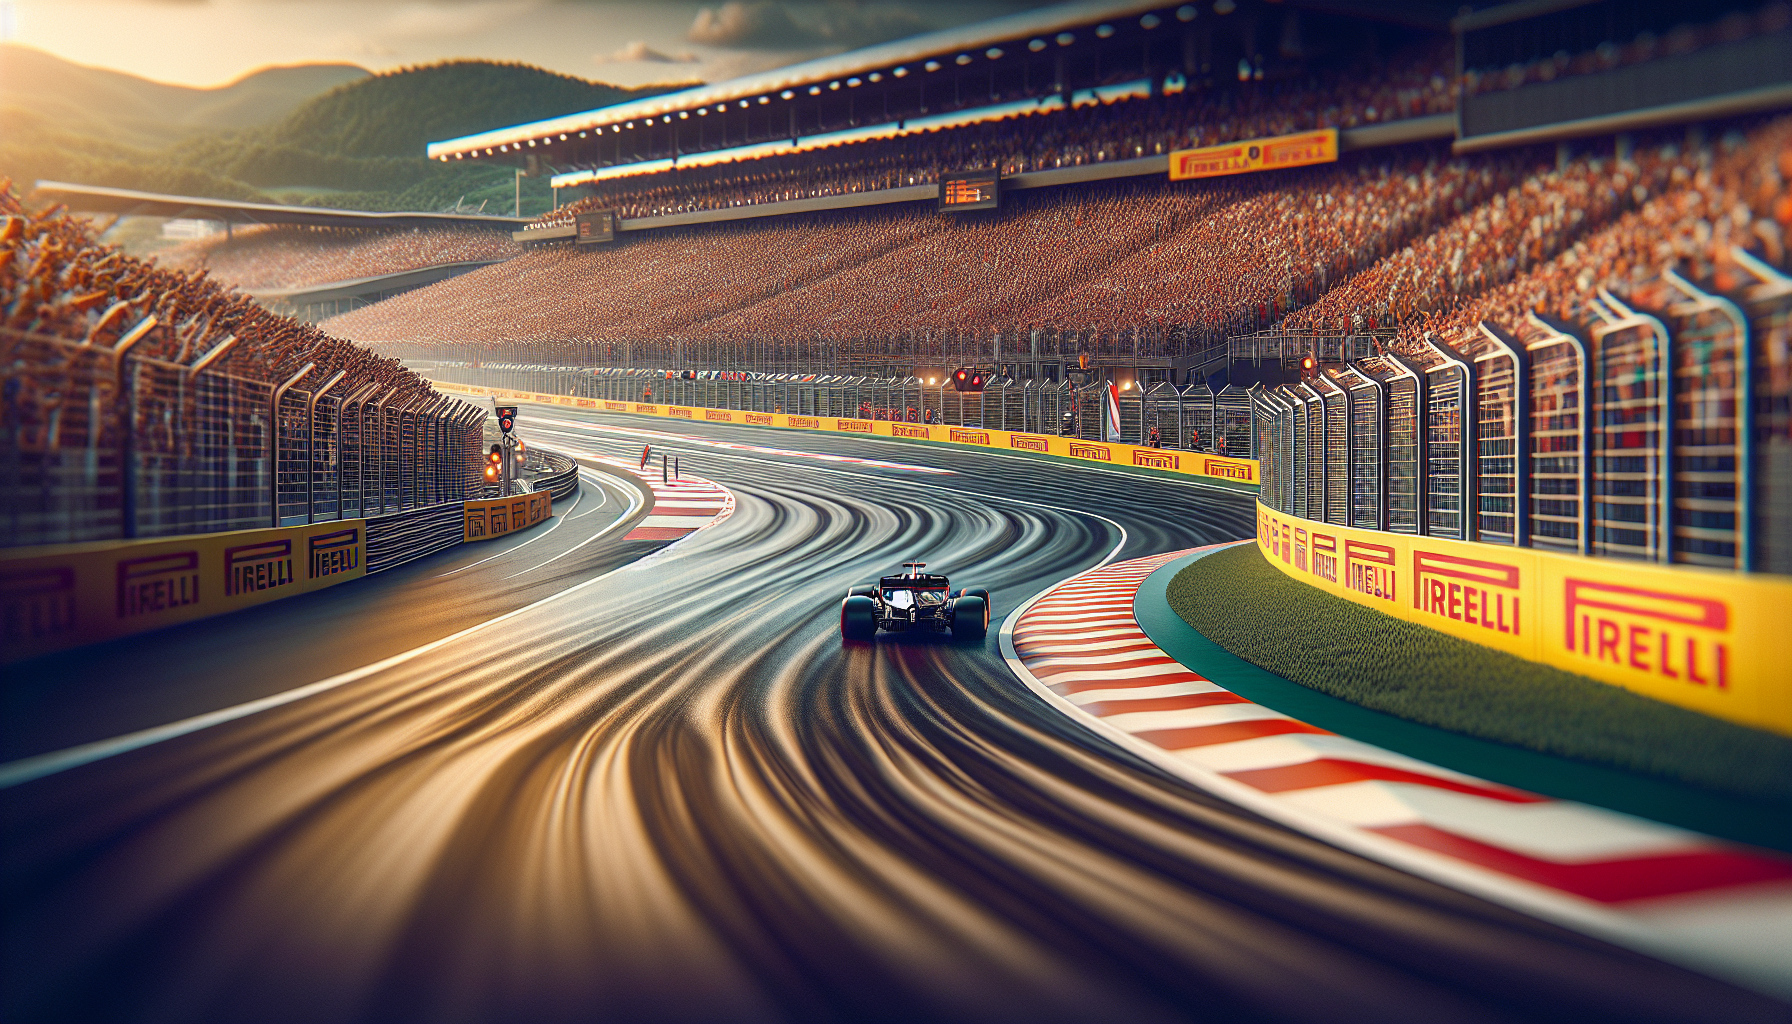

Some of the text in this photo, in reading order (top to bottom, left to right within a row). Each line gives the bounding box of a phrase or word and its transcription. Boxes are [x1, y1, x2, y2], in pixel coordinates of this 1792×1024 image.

[224, 538, 294, 597] PIRELLI
[1413, 550, 1520, 636] PIREELLI
[1563, 576, 1730, 688] PIRELLI
